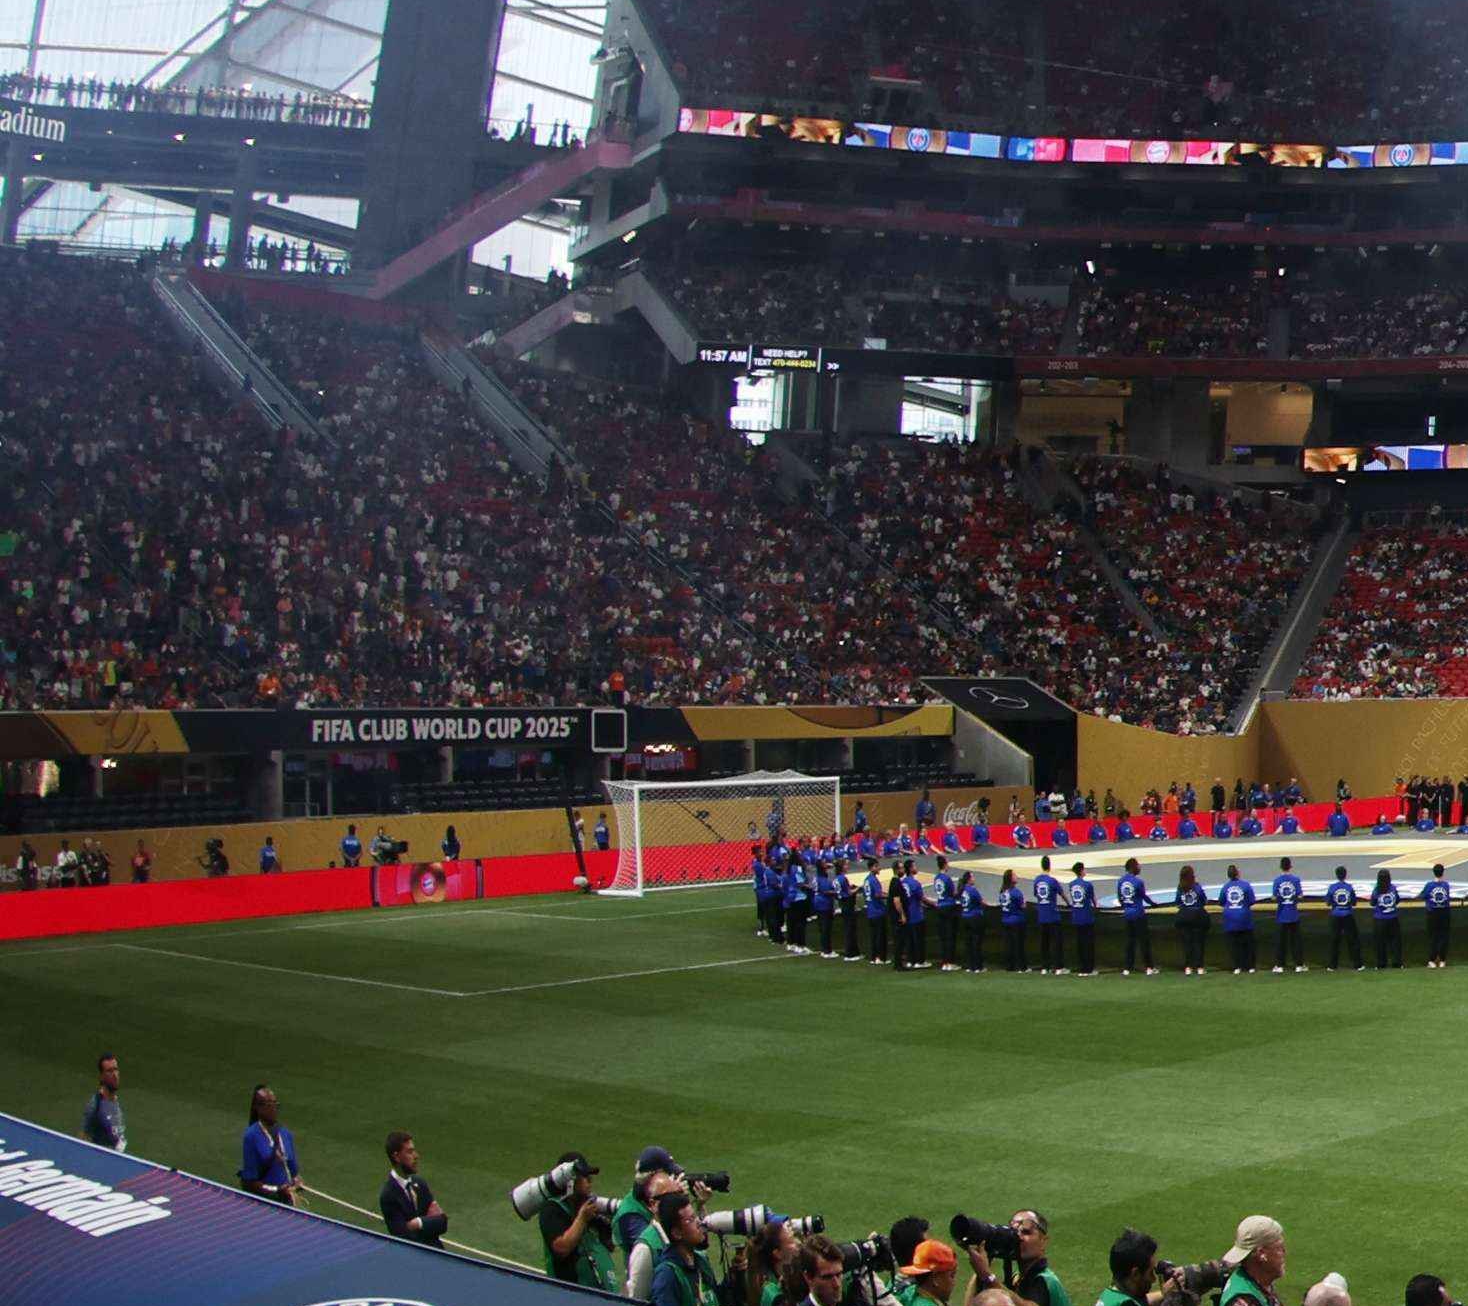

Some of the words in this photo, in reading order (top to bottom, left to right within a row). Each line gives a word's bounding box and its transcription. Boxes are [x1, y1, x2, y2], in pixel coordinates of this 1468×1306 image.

[729, 351, 747, 362] AM
[311, 720, 355, 743] FIFA
[359, 718, 407, 741] CLUB
[411, 717, 481, 741] WORLD
[484, 717, 522, 739] CUP
